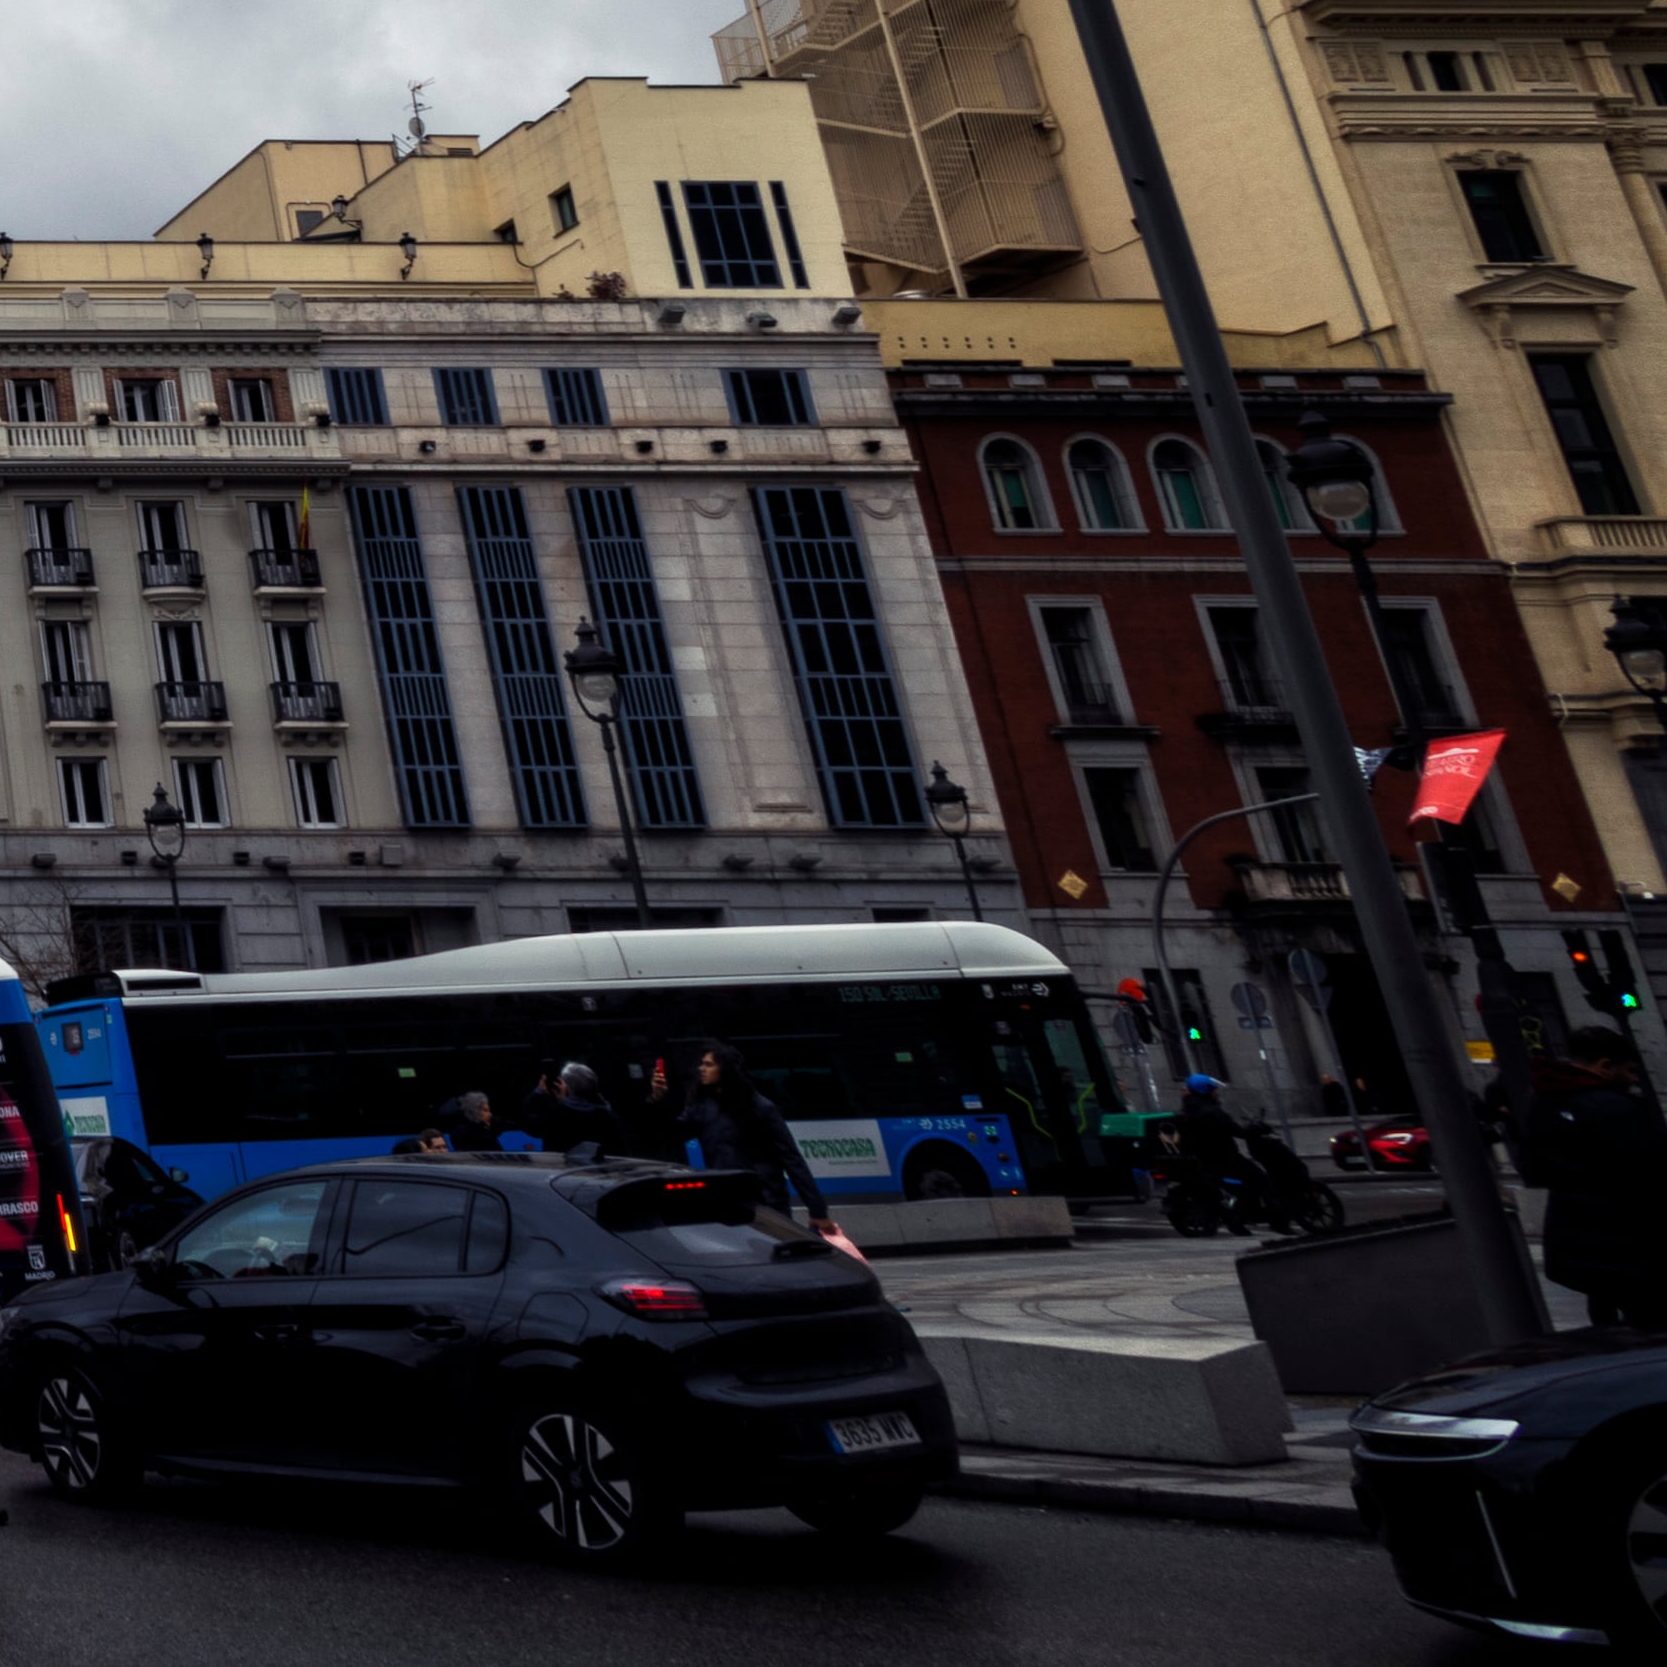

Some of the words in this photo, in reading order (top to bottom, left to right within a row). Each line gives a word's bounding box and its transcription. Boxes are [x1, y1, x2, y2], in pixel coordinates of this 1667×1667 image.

[936, 1118, 967, 1130] 2554
[799, 1138, 877, 1158] TECNOCASA
[834, 1418, 883, 1448] 3635
